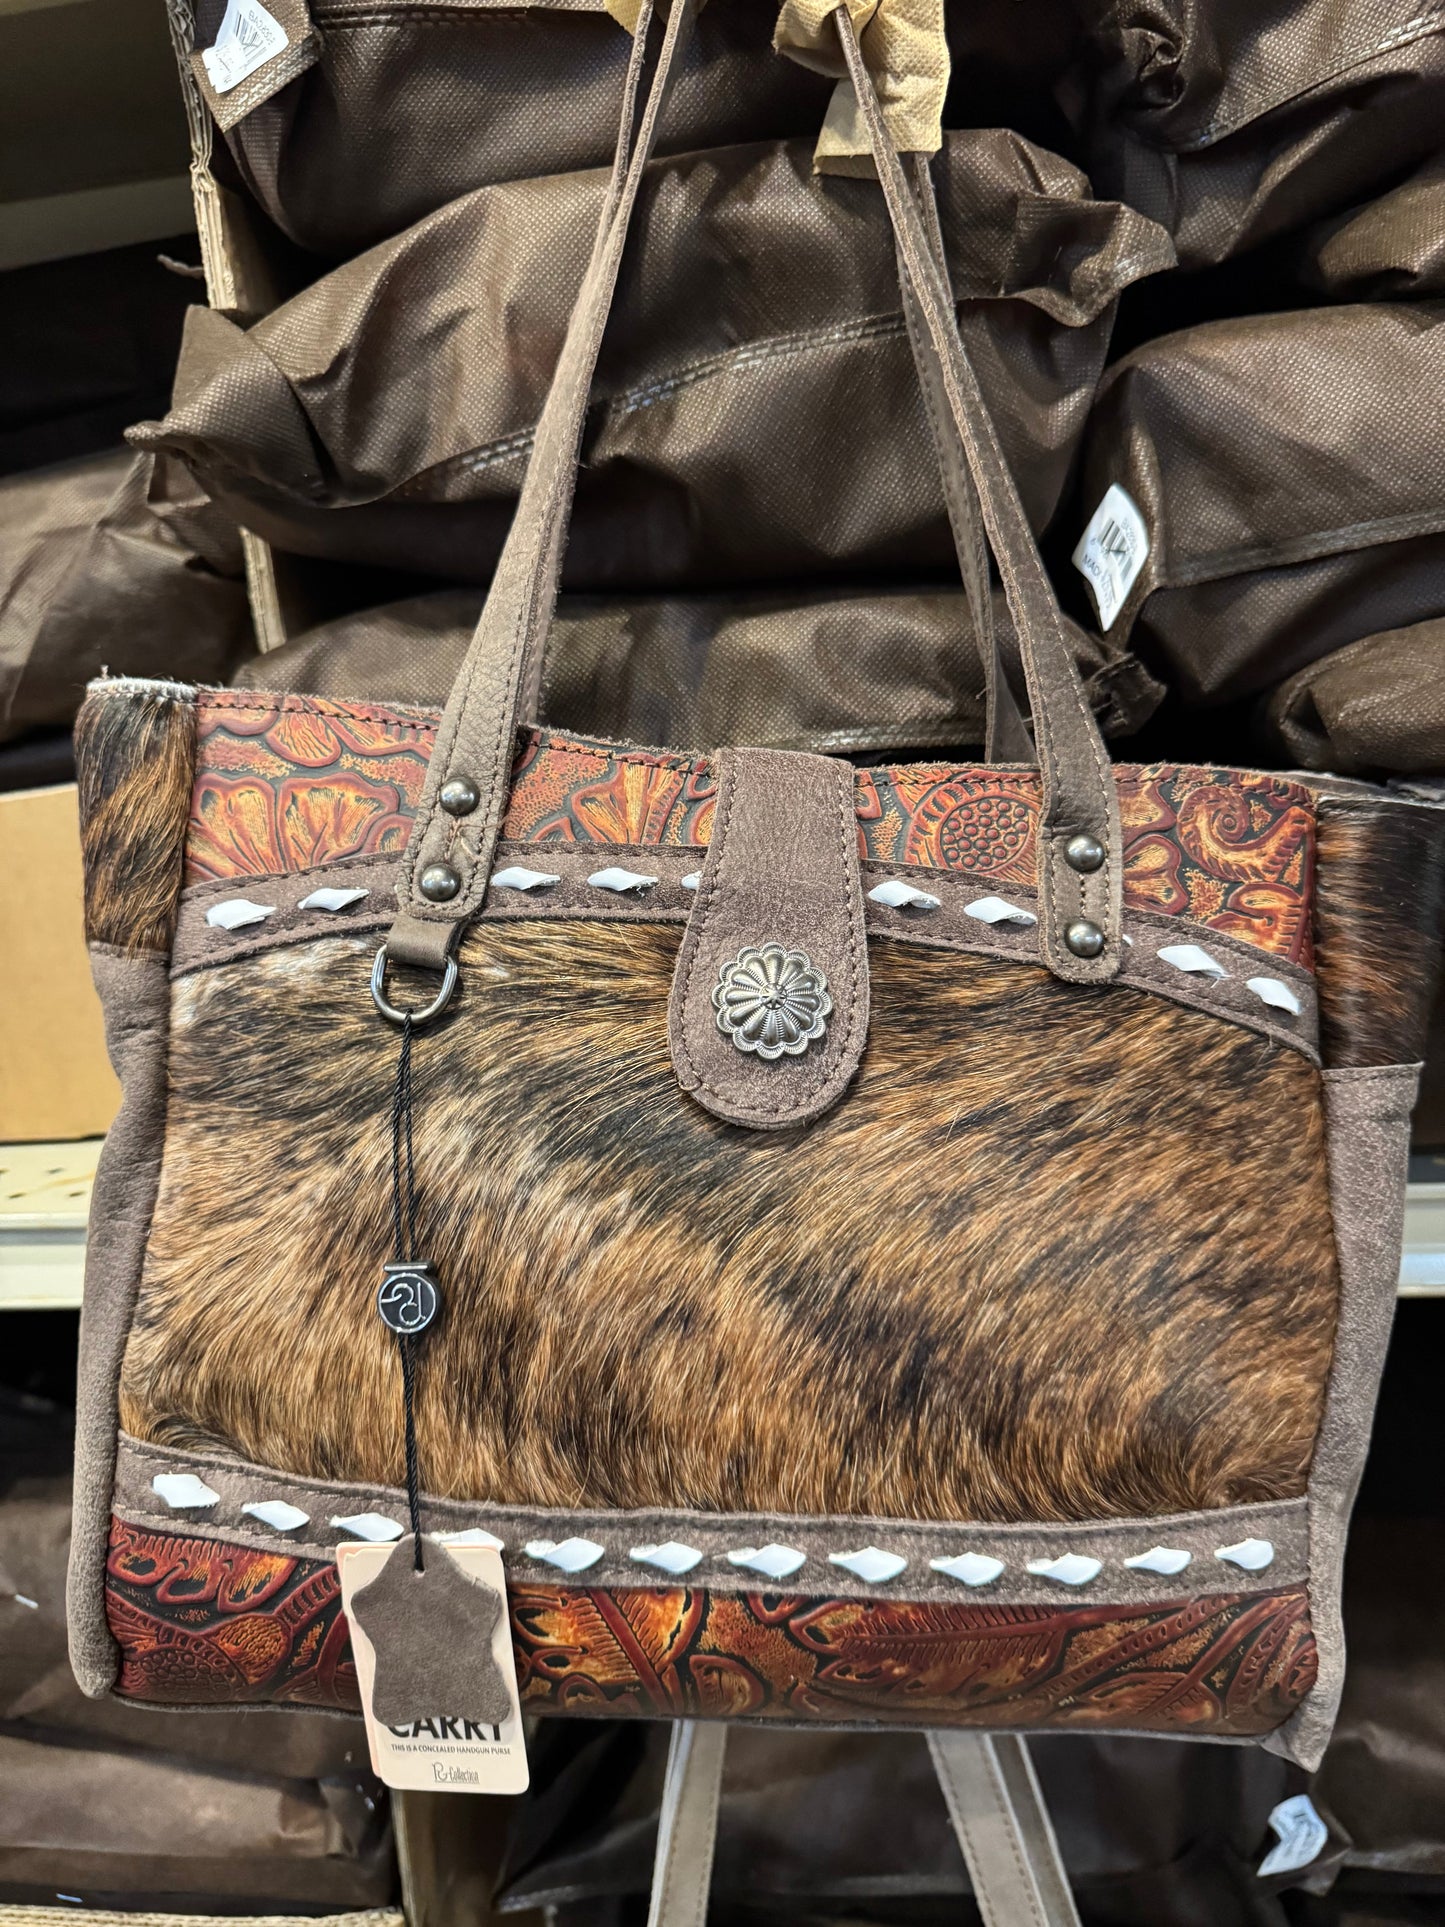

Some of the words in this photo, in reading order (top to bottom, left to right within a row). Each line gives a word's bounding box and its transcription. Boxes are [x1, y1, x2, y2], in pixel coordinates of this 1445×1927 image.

[391, 1744, 405, 1752] THIS
[406, 1744, 412, 1752] IS
[413, 1744, 418, 1752] A
[418, 1744, 456, 1754] CONCEALED
[456, 1745, 490, 1755] HANDGUN
[491, 1746, 511, 1756] PURSE
